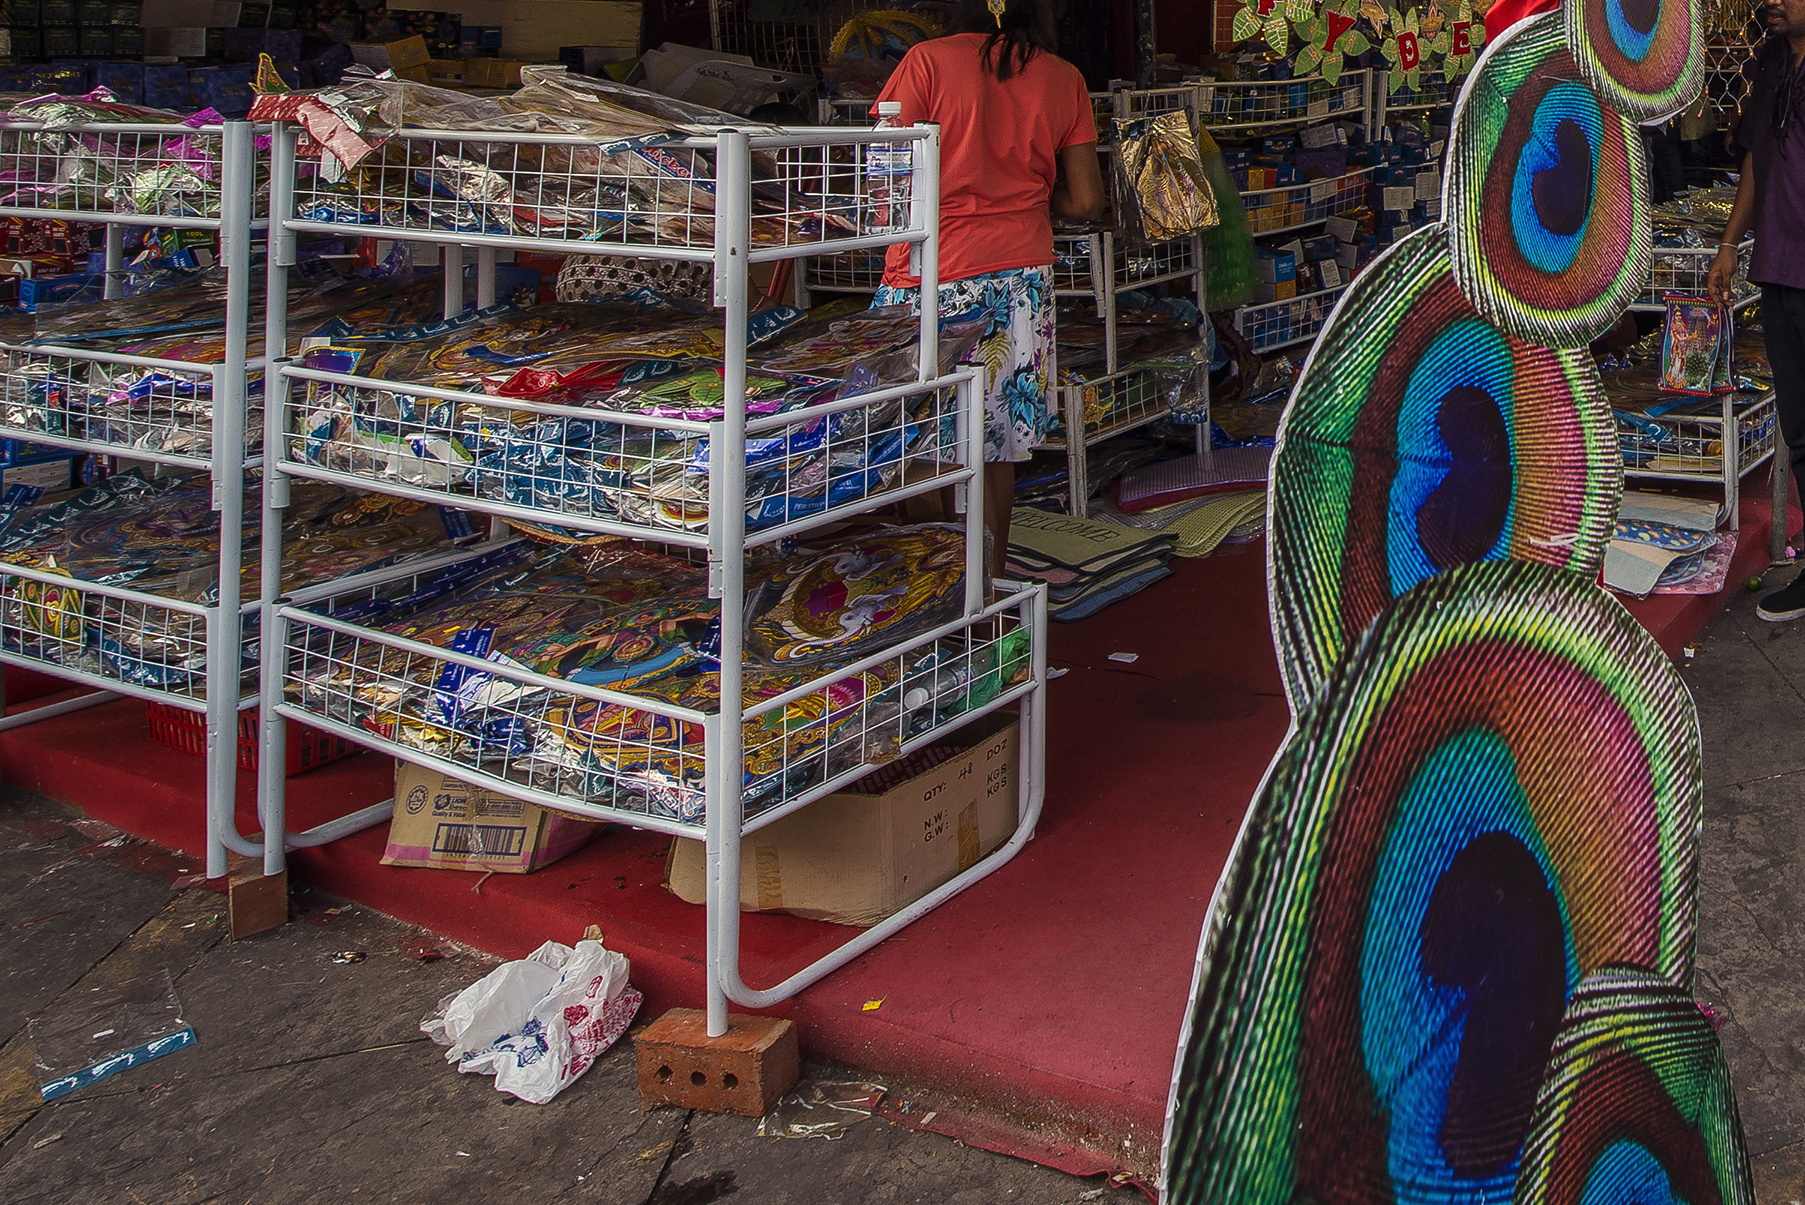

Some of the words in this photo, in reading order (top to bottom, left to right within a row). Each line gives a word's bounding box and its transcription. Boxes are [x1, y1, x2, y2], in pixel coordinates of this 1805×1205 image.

[923, 781, 948, 802] QTY:
[957, 761, 973, 780] 48
[986, 738, 1008, 762] DOZ
[986, 762, 1007, 786] KGS
[986, 776, 1007, 799] KGS
